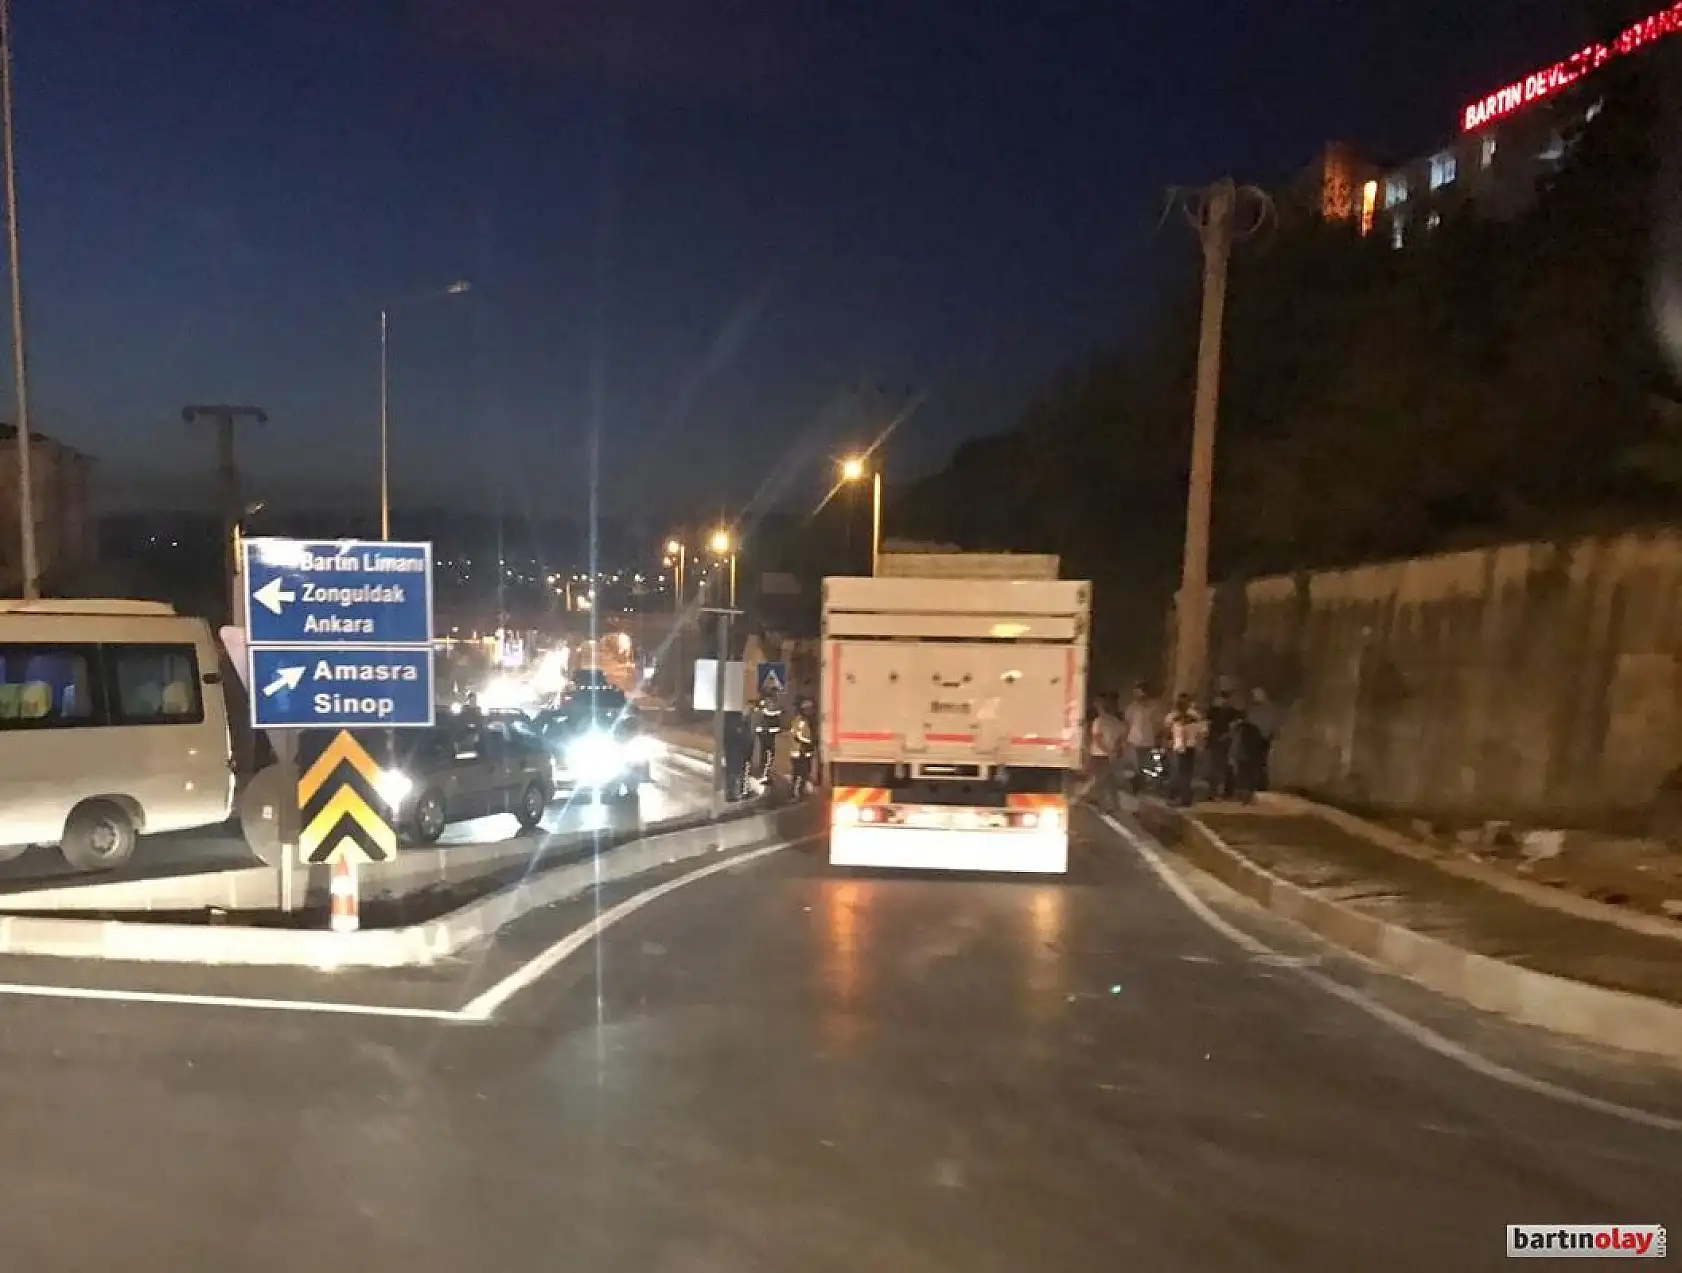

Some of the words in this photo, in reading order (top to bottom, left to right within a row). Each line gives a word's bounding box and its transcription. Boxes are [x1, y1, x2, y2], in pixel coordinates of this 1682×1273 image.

[301, 583, 405, 607] Zonguldak
[303, 613, 375, 633] Ankara
[313, 659, 418, 681] Amasra
[313, 693, 394, 718] Sinop
